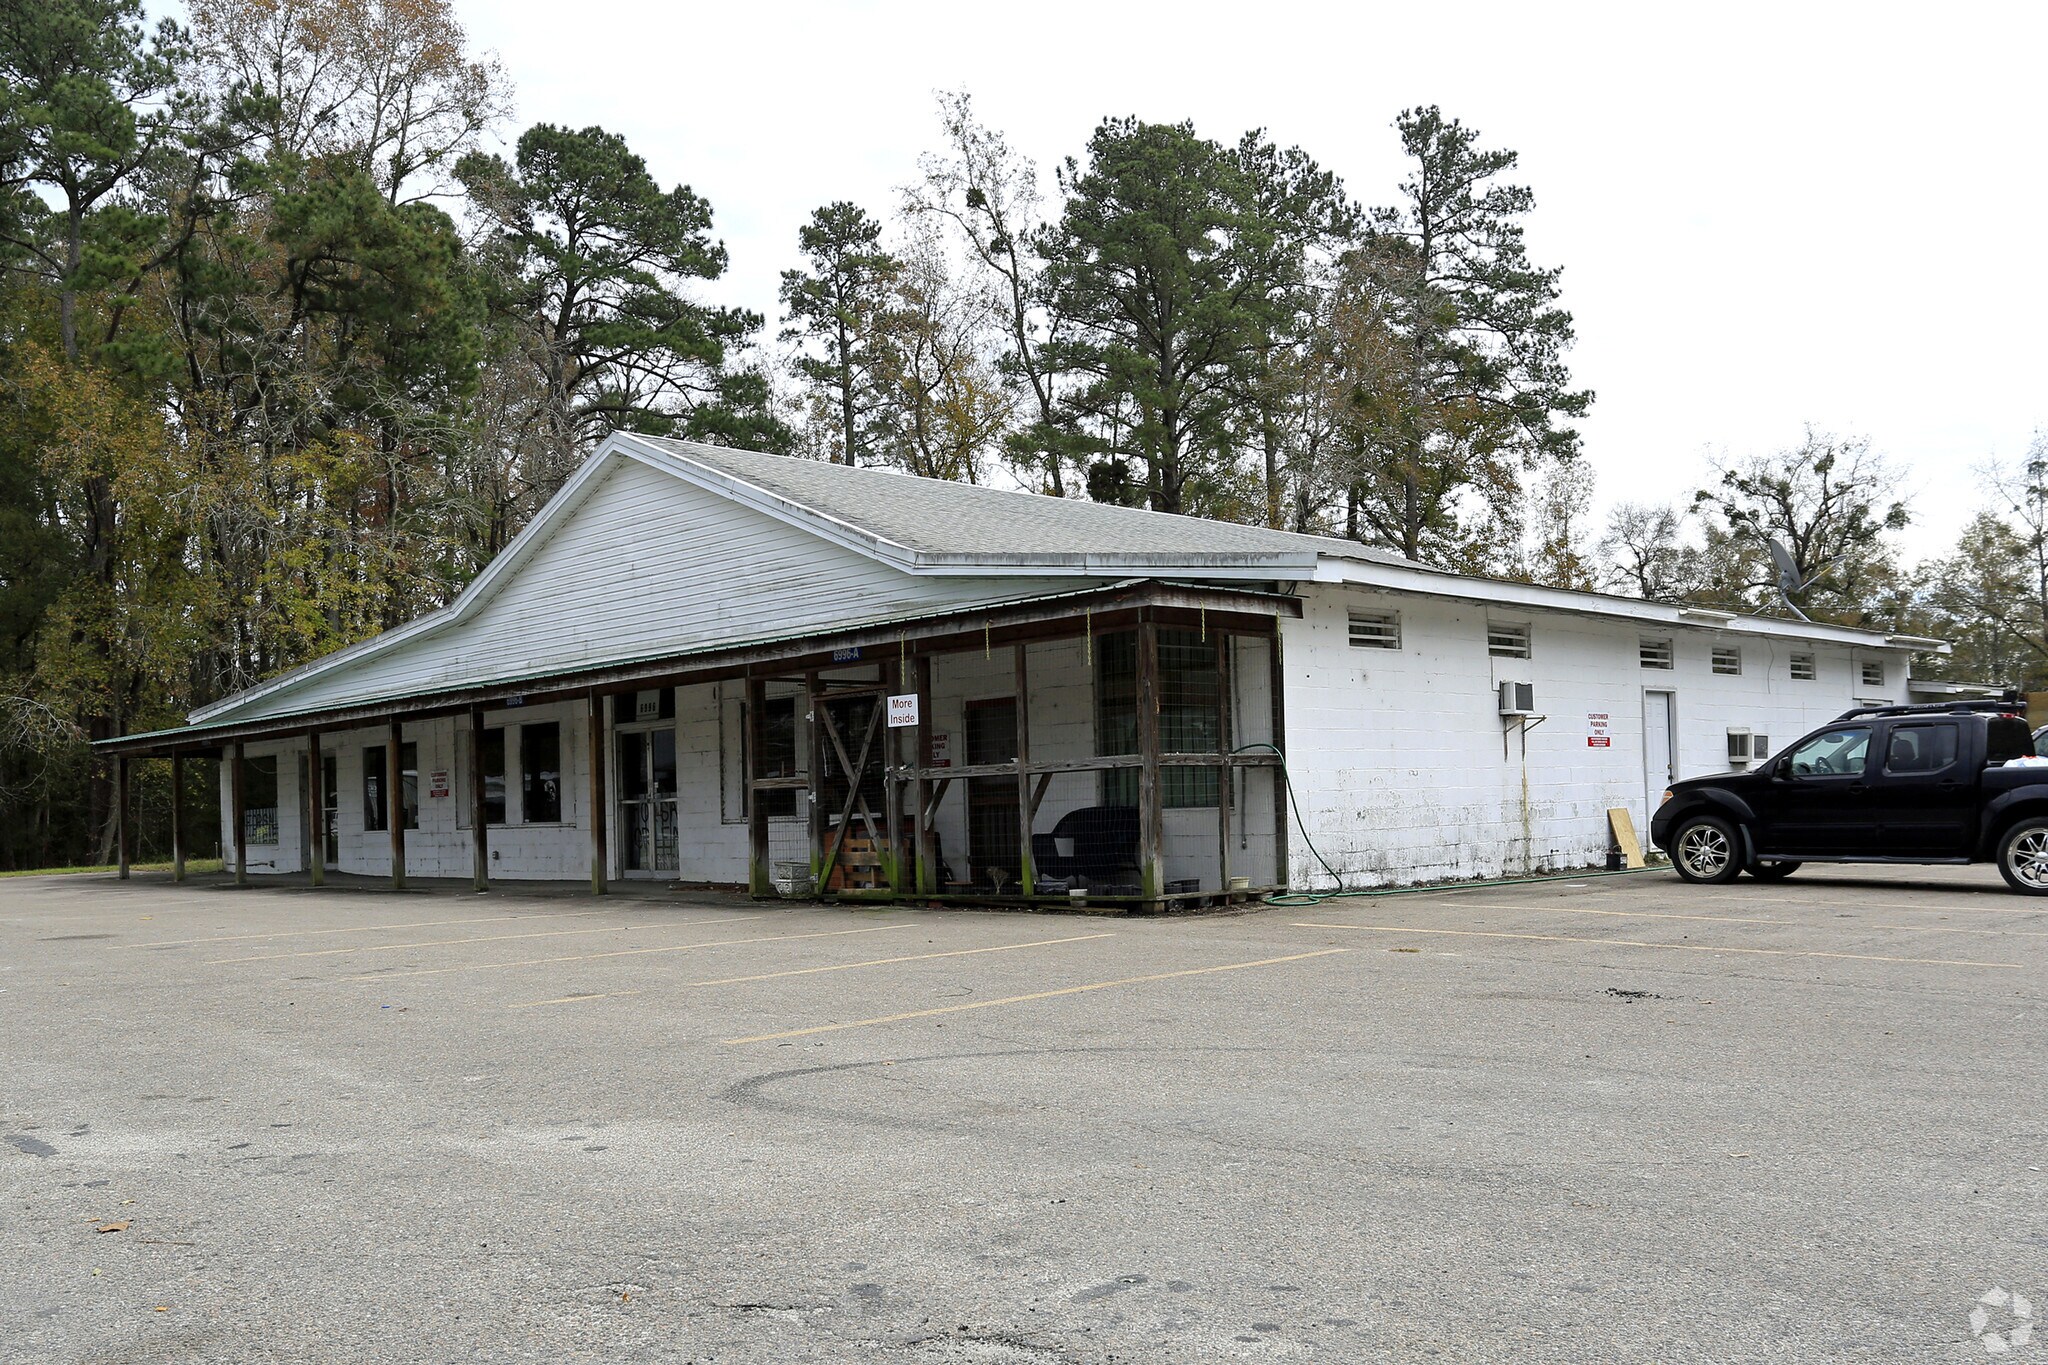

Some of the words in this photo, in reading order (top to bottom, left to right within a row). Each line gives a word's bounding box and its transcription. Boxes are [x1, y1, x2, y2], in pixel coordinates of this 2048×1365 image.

[834, 648, 859, 661] 6996-A
[892, 699, 912, 709] More
[890, 713, 914, 724] Inside
